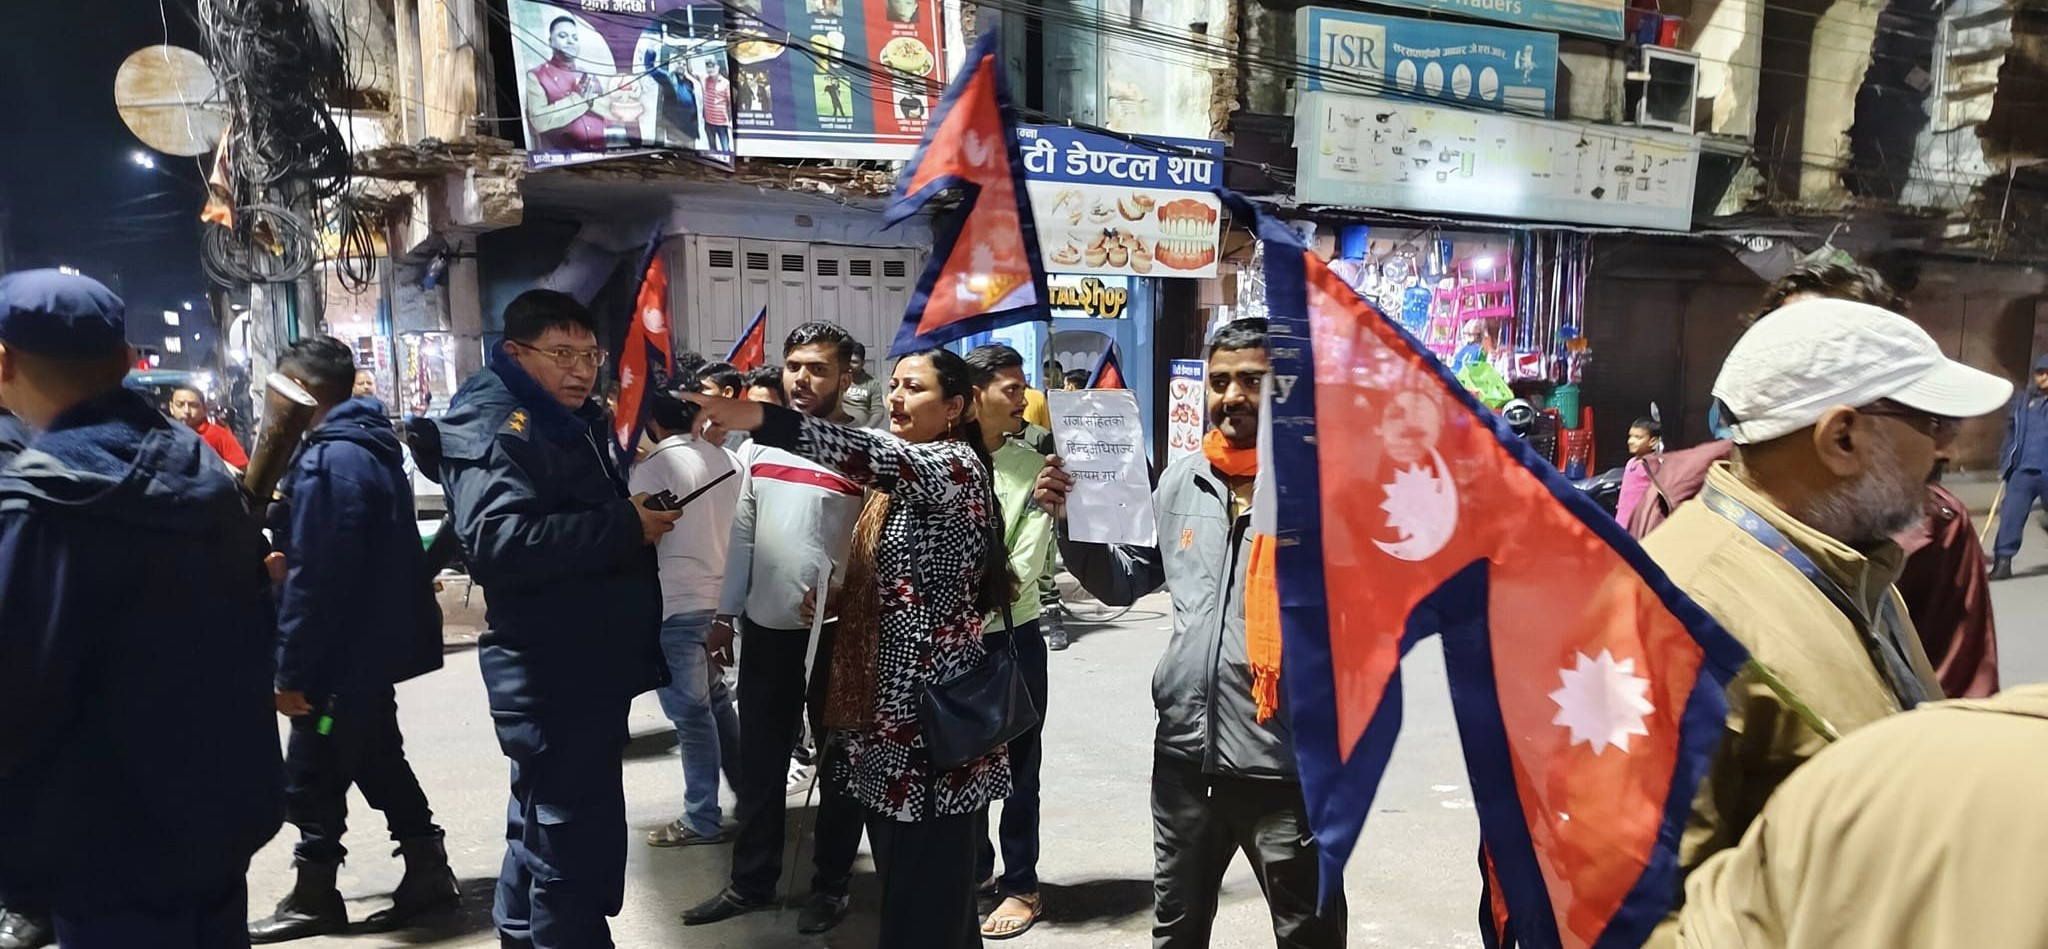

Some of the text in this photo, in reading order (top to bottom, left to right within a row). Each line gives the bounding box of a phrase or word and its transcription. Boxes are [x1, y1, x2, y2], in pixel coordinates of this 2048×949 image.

[1326, 33, 1380, 69] JSR
[1019, 138, 1215, 185] टी डेण्टल शप
[1048, 286, 1080, 306] TAL
[1071, 470, 1099, 480] कायम
